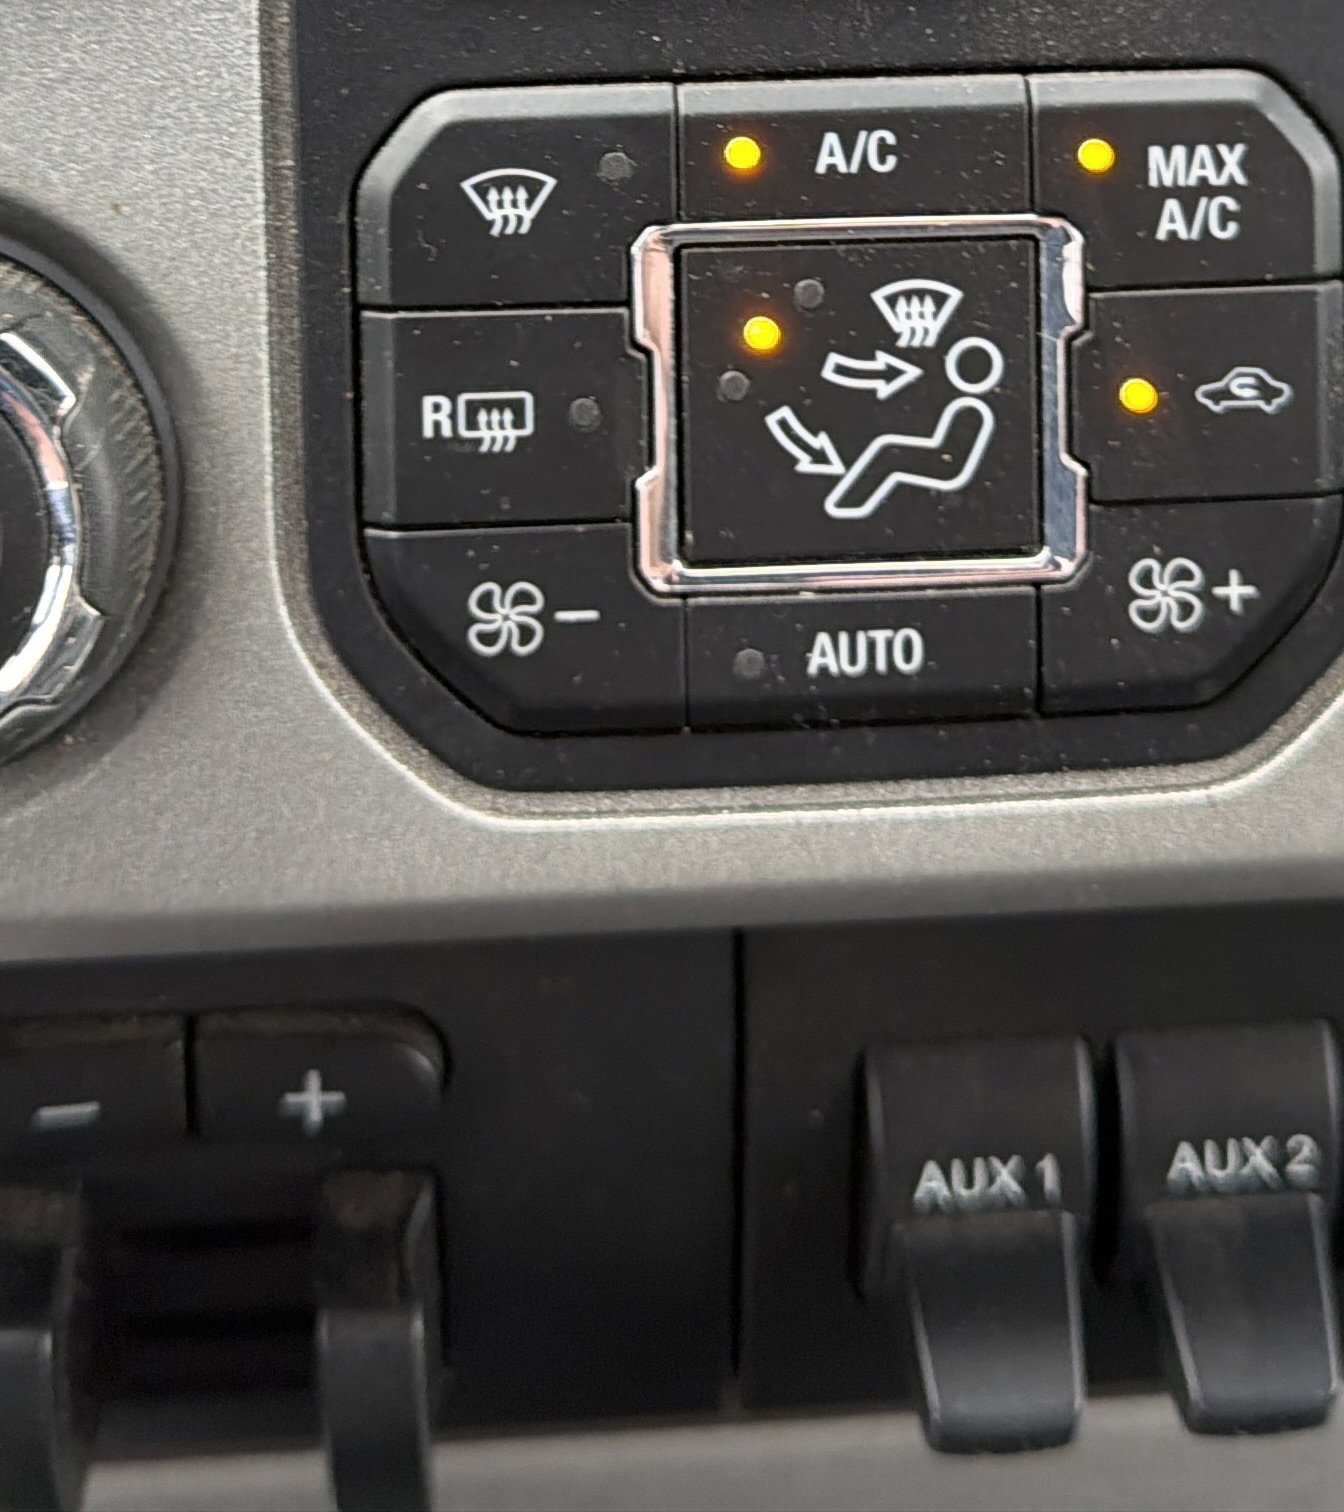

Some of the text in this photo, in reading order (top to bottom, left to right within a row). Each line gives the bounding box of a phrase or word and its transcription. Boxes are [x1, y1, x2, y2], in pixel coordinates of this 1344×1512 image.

[814, 128, 899, 176] A/C
[1146, 143, 1249, 189] MAX
[1154, 194, 1241, 242] A/C
[422, 394, 454, 440] R
[806, 627, 924, 677] AUTO
[912, 1152, 1062, 1211] AUX 1
[1166, 1132, 1321, 1191] AUX 2
